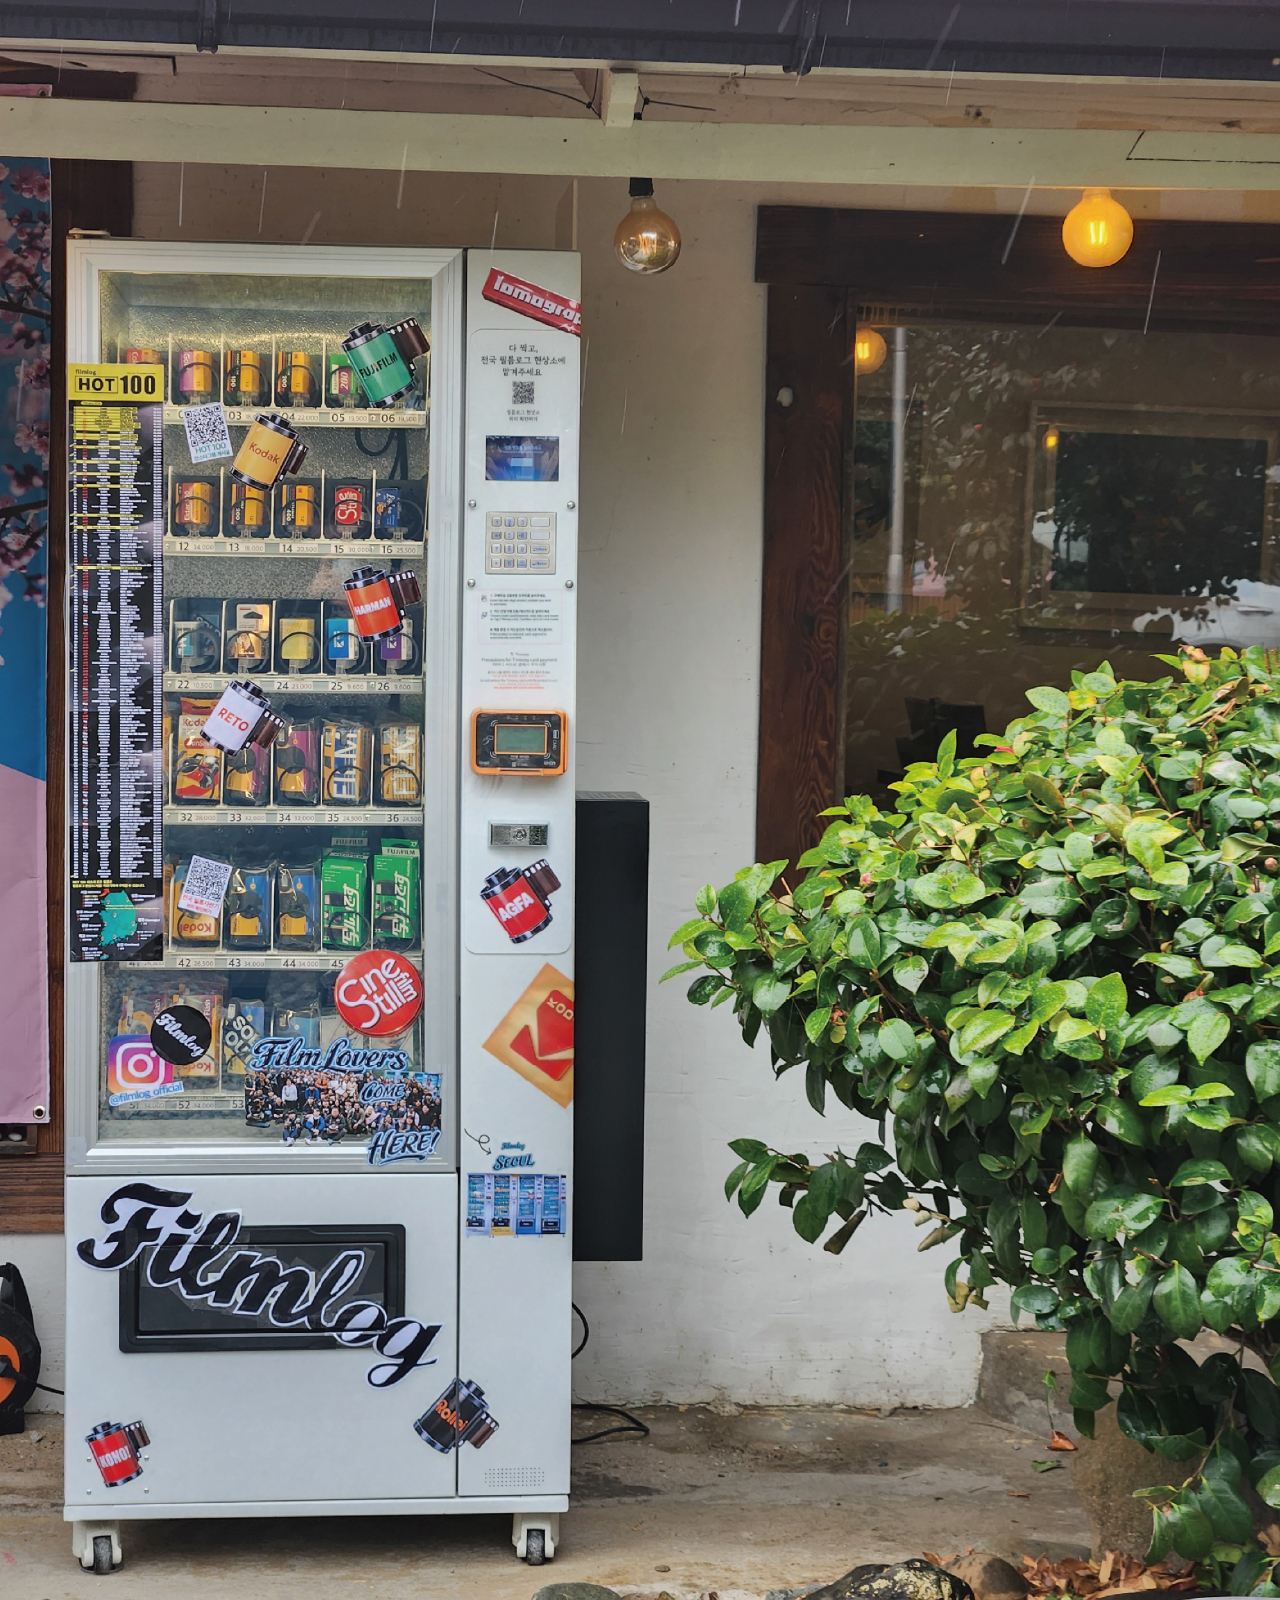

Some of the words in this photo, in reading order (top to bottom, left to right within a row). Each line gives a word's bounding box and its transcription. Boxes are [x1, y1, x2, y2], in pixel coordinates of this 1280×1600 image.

[481, 355, 497, 365] 전국
[499, 355, 532, 365] 필름로그
[534, 355, 566, 365] 현상소에
[358, 352, 398, 379] FUJIFILM
[502, 367, 542, 377] 맡겨주세요
[78, 377, 115, 392] HOT
[120, 374, 156, 395] 100
[340, 371, 349, 391] 200
[229, 411, 242, 421] 03
[331, 413, 345, 422] 05
[381, 414, 395, 423] 06
[195, 444, 212, 454] HOT
[212, 442, 227, 451] 100
[248, 441, 280, 465] Kodak
[178, 542, 189, 551] 12
[229, 543, 240, 552] 13
[282, 544, 293, 553] 14
[334, 545, 344, 553] 15
[381, 545, 393, 554] 16
[353, 596, 392, 616] HARMAN
[177, 680, 189, 689] 22
[277, 682, 289, 690] 24
[331, 682, 343, 691] 25
[378, 682, 390, 691] 26
[182, 717, 208, 727] Koda
[217, 707, 250, 732] RETO
[181, 813, 193, 822] 32
[229, 813, 242, 822] 33
[278, 813, 292, 822] 34
[327, 813, 339, 822] 35
[386, 813, 399, 822] 36
[387, 847, 416, 857] FUJIFILM
[182, 893, 193, 903] 전국
[498, 890, 534, 922] AGFA
[178, 958, 191, 967] 42
[228, 958, 241, 967] 43
[282, 958, 296, 968] 44
[331, 959, 344, 968] 45
[338, 958, 401, 1008] Cine
[395, 971, 418, 1002] film
[546, 997, 575, 1021] KOD
[155, 1012, 206, 1058] Filmlog
[251, 1036, 323, 1069] Film
[316, 1036, 407, 1074] Lovers
[109, 1081, 184, 1106] @filmlog_official
[361, 1082, 405, 1103] COME
[178, 1100, 190, 1109] 52
[232, 1100, 244, 1109] 53
[368, 1130, 441, 1166] HERE!
[492, 1153, 536, 1171] SEOUL
[76, 1182, 445, 1388] Filmlog
[98, 1444, 132, 1468] KONO!
